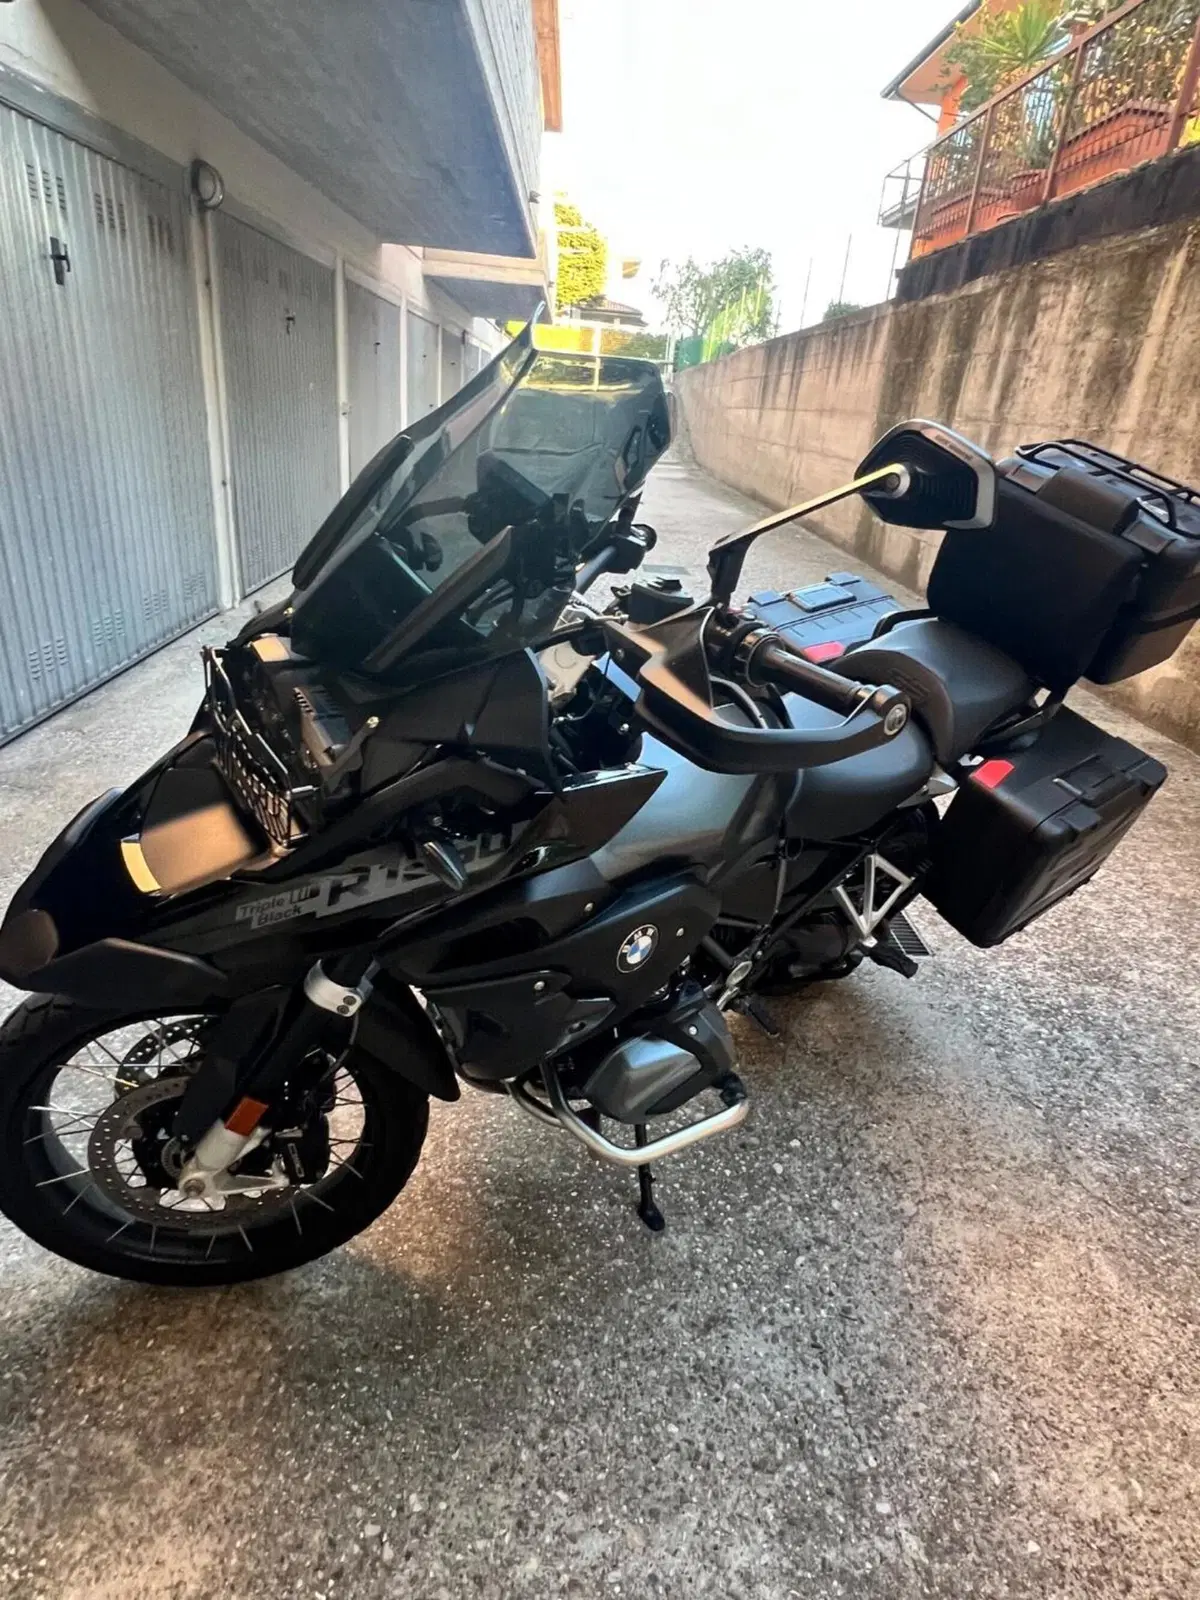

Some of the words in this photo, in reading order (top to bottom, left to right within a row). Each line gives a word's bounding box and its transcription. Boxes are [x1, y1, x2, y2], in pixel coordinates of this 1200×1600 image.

[239, 895, 286, 916] Triple
[257, 904, 303, 926] Black
[621, 928, 655, 953] BMW
